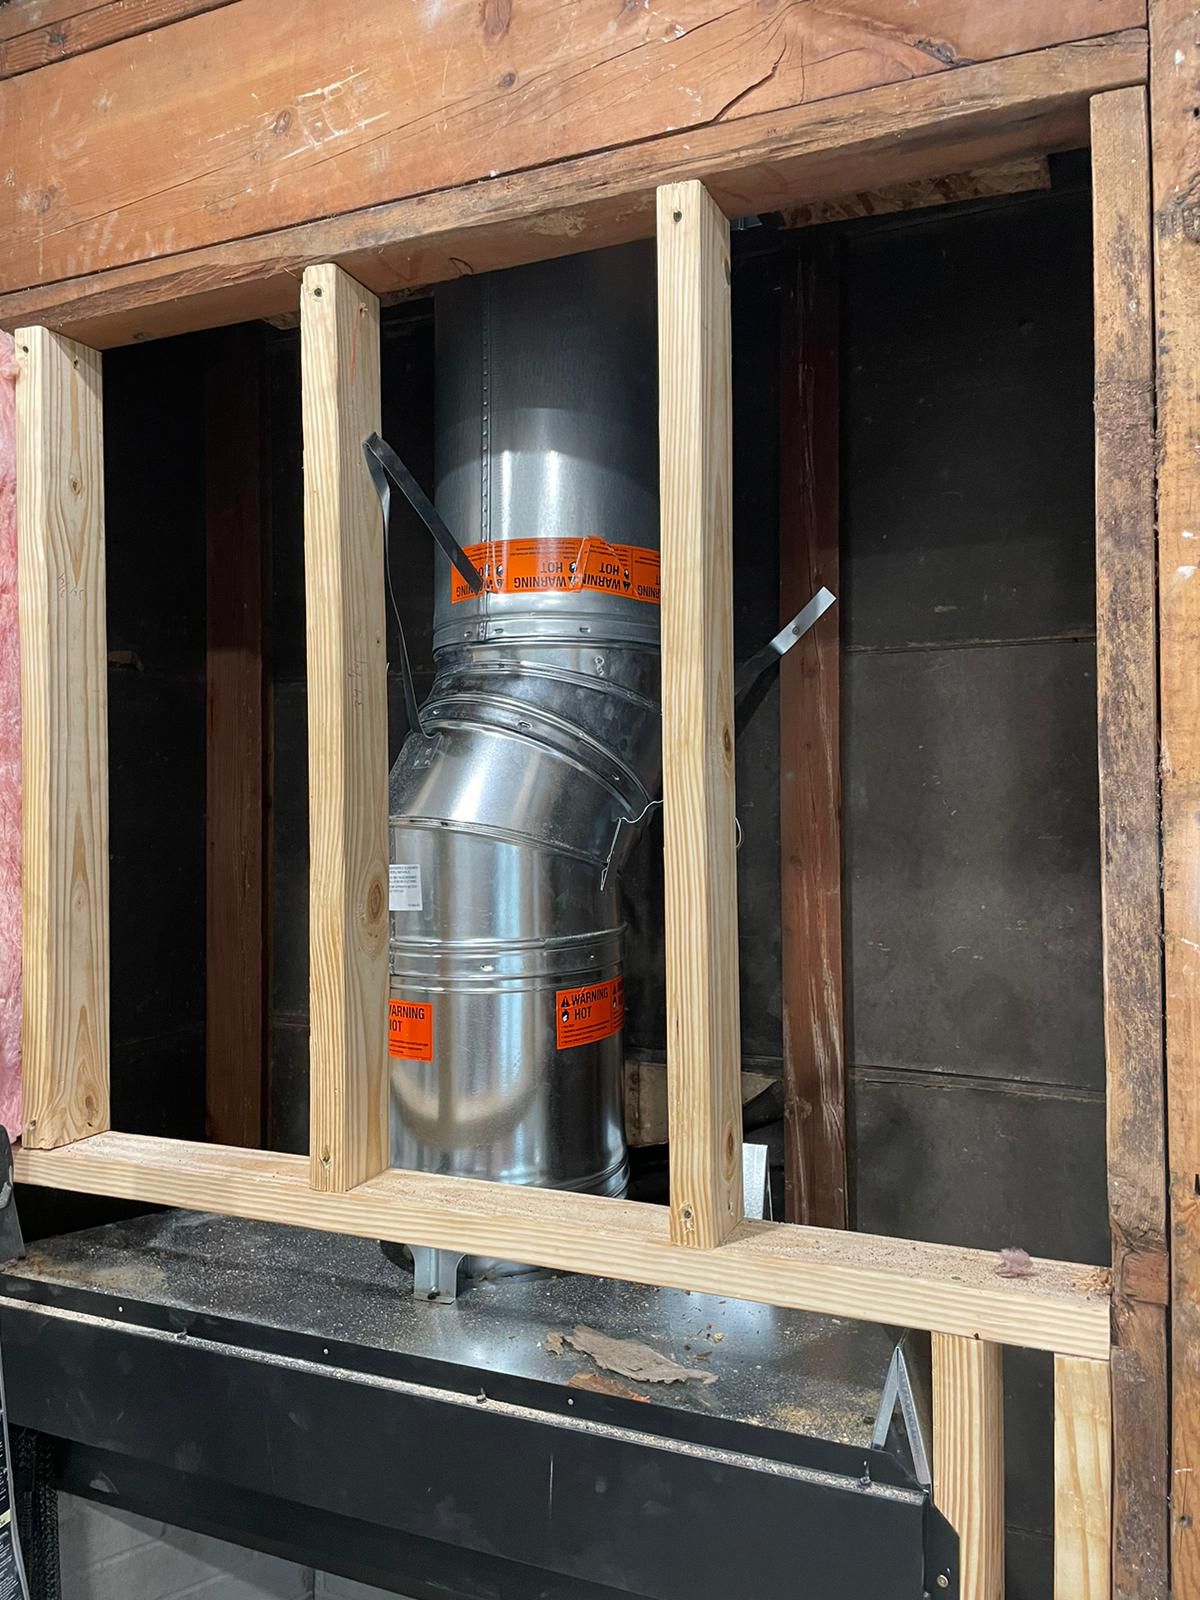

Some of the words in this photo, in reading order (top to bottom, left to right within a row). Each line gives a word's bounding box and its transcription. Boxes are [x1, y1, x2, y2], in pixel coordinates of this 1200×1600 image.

[541, 561, 563, 575] HOT
[599, 562, 620, 576] HOT
[513, 575, 567, 589] WARNING
[582, 573, 621, 591] WARNIN
[637, 584, 660, 599] RNING
[571, 986, 609, 1006] WARNING
[389, 1004, 425, 1020] ARNING
[574, 1005, 592, 1021] HOT
